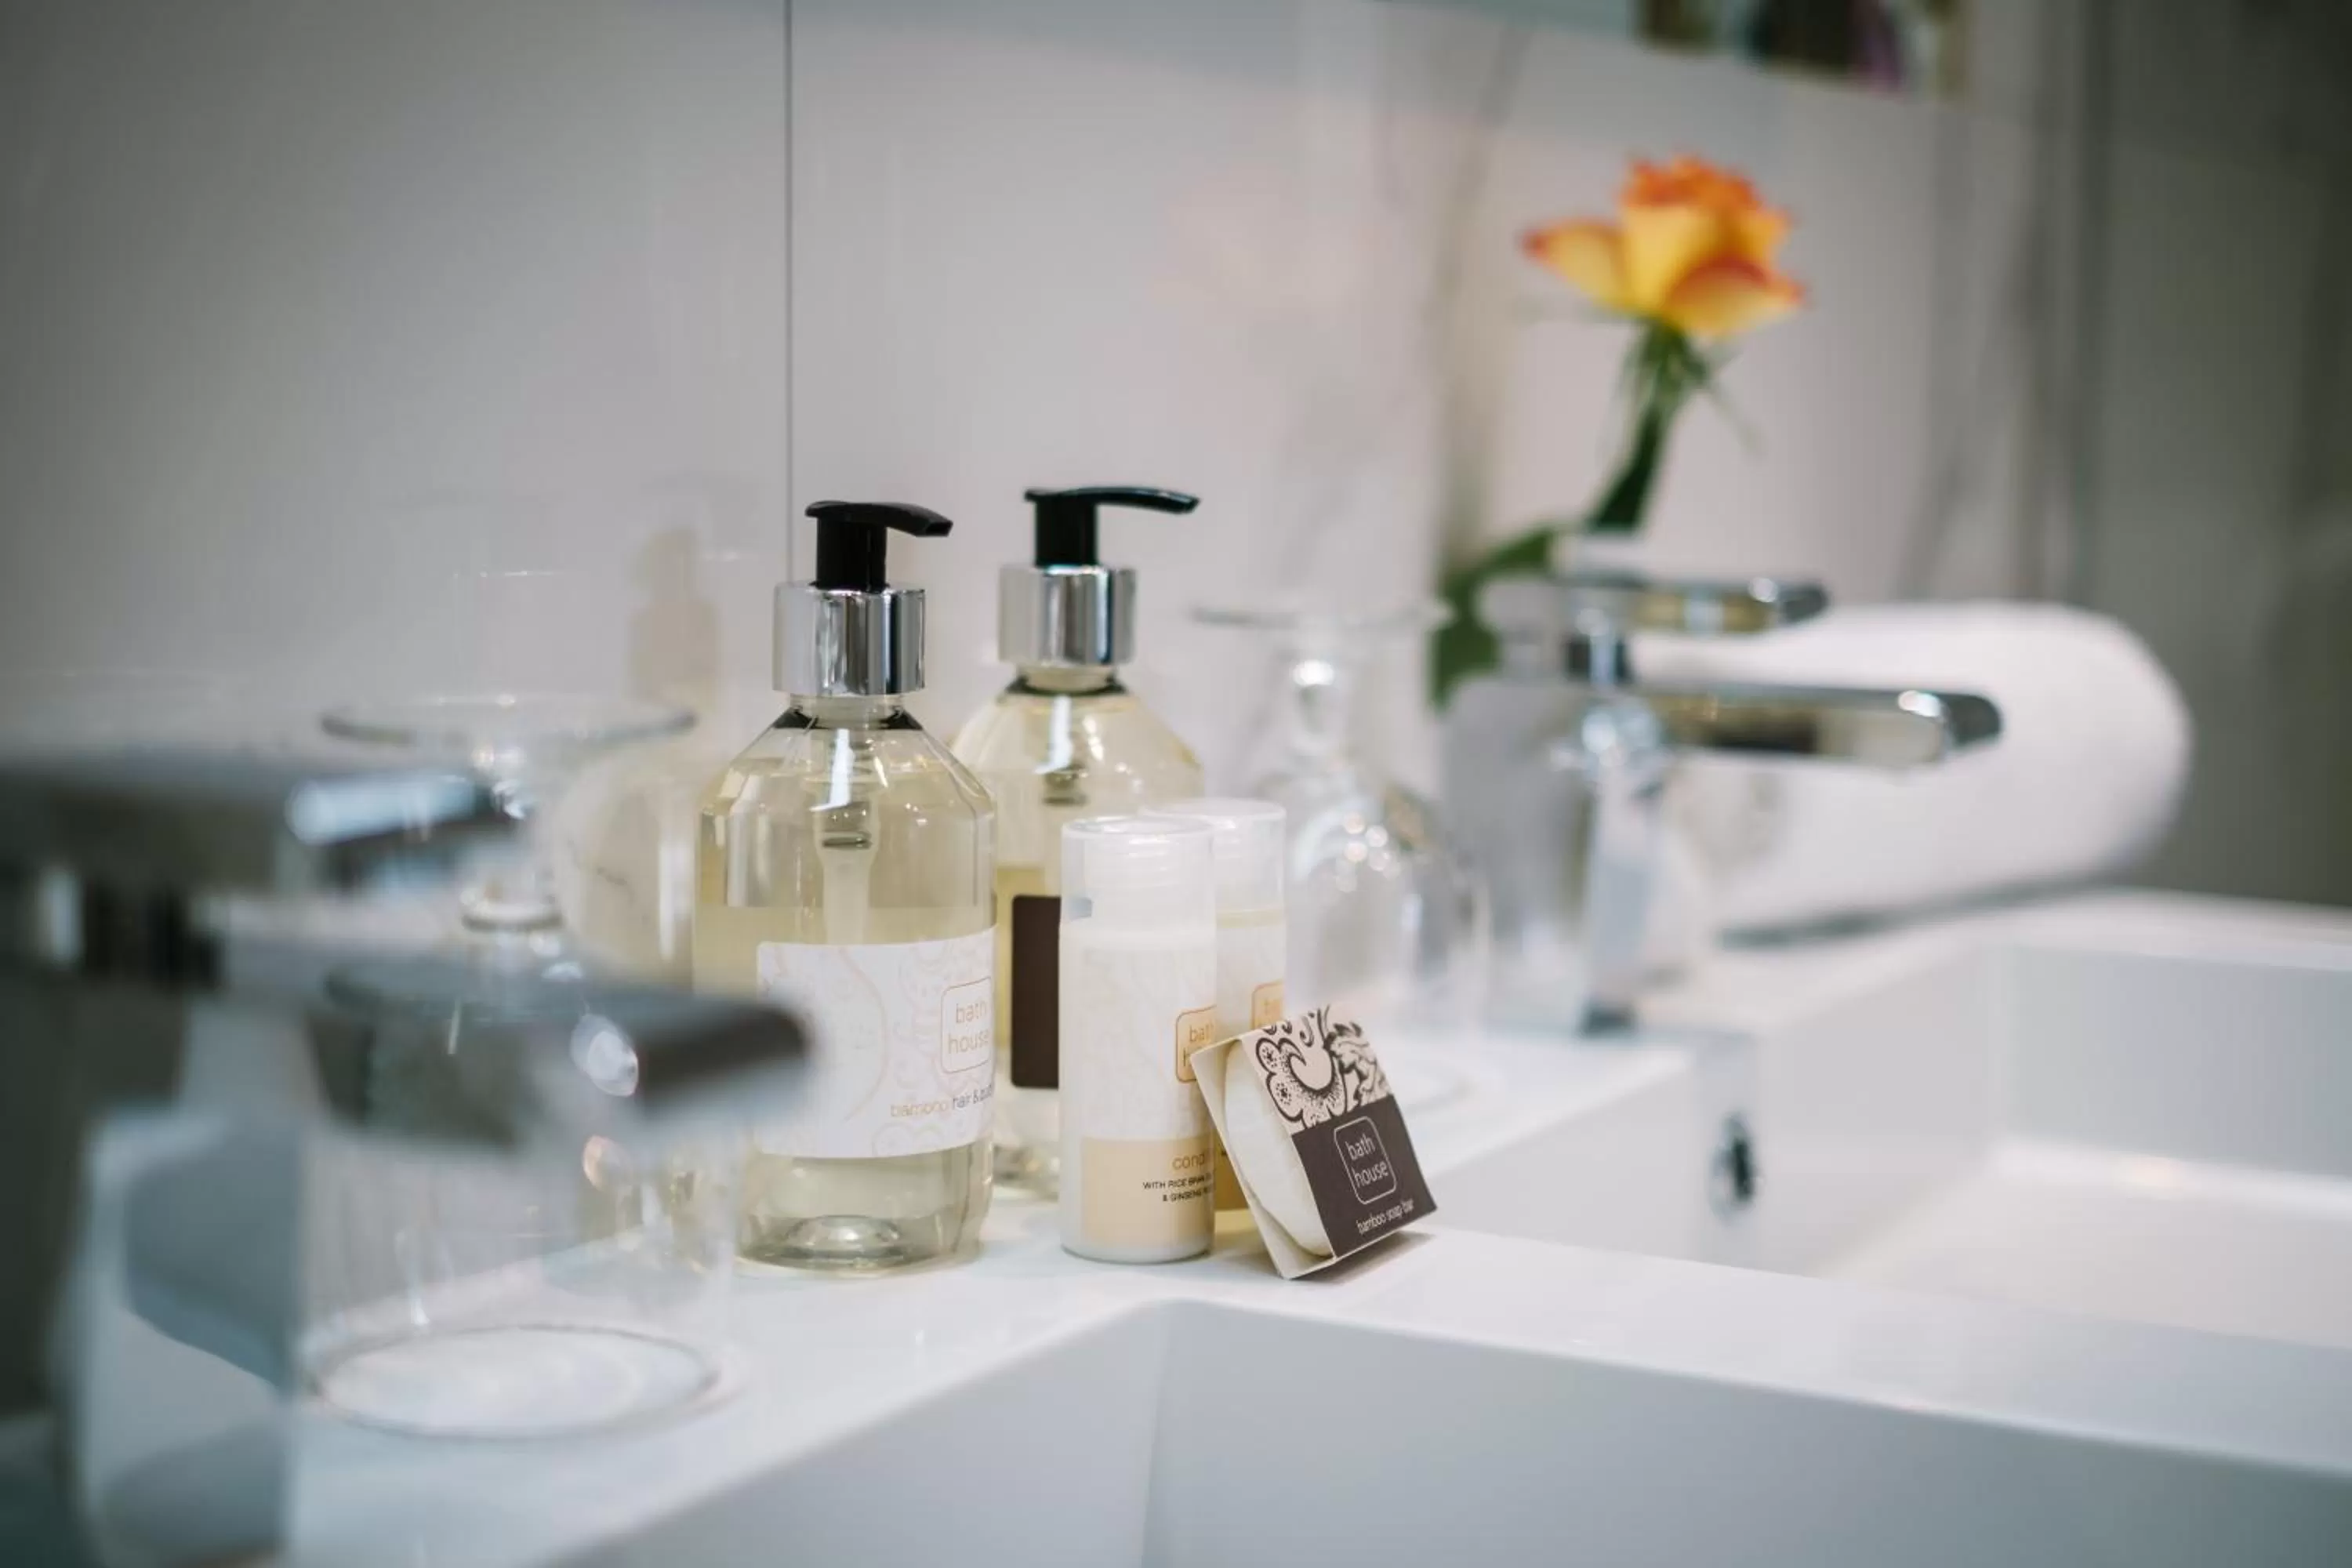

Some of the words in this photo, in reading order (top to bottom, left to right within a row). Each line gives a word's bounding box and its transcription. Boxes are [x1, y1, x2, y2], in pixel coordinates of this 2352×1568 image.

[956, 997, 987, 1023] bath
[947, 1029, 989, 1054] house
[1345, 1133, 1376, 1160] bath
[1143, 1181, 1166, 1189] WITH
[1168, 1178, 1187, 1188] RICE
[1351, 1161, 1388, 1188] house
[1356, 1213, 1386, 1235] bamboo
[1385, 1205, 1403, 1221] soap
